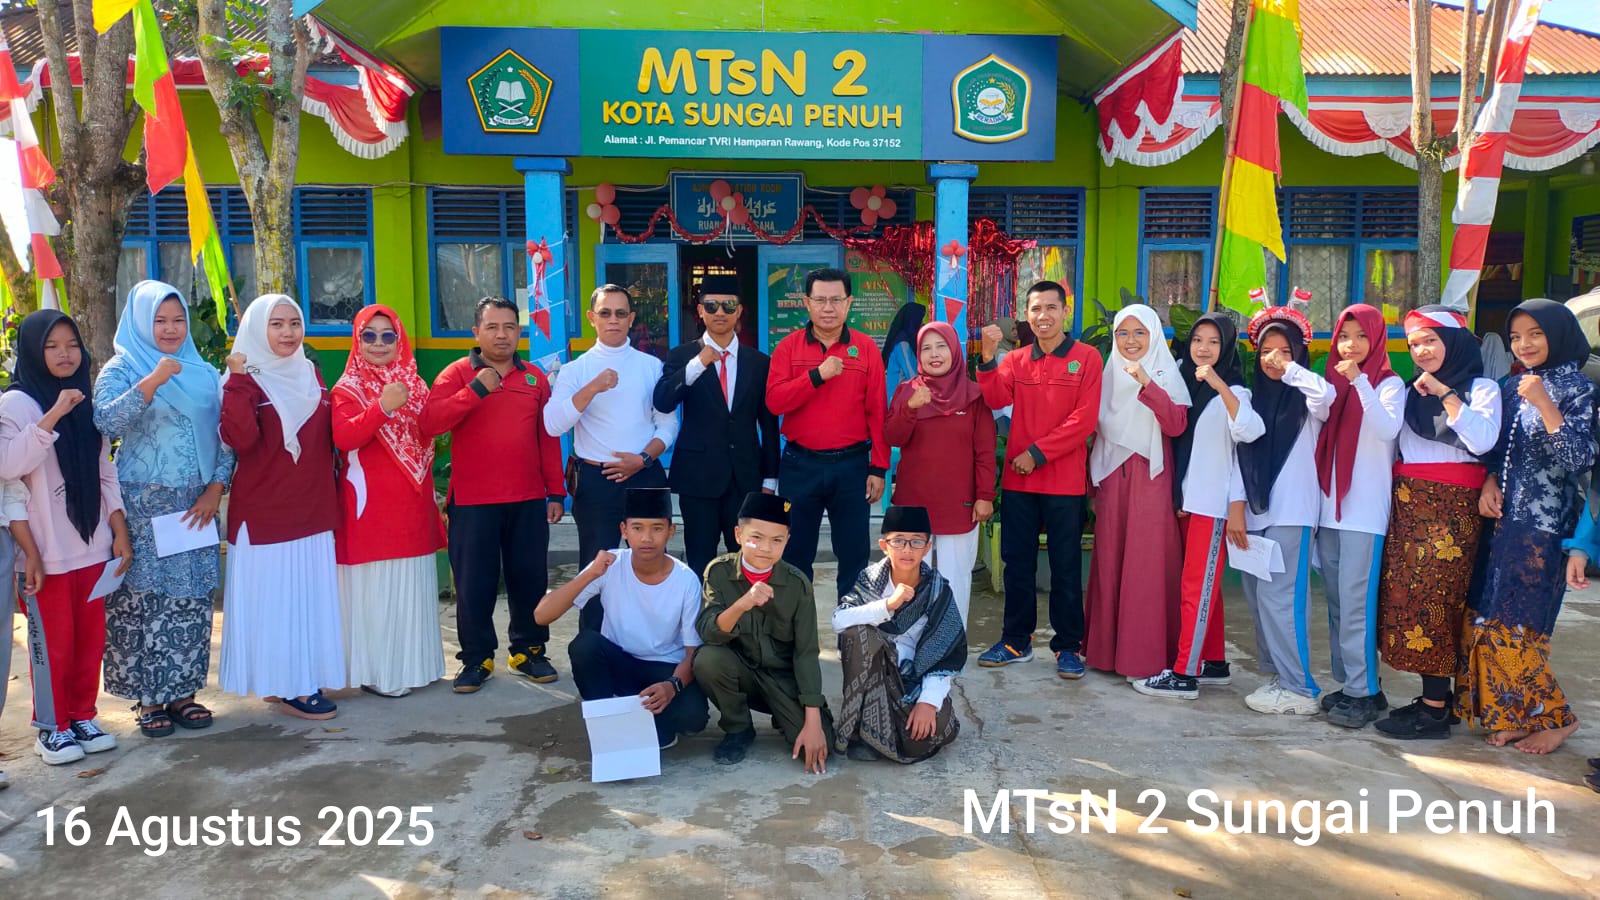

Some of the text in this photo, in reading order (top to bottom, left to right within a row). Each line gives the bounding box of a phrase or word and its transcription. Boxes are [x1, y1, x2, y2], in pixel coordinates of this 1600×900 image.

[638, 47, 868, 97] MTsN 2
[602, 101, 902, 128] KOTA SUNGAI PENUH
[603, 134, 638, 145] Alamat
[658, 135, 707, 146] Pemancar
[708, 136, 731, 146] TVRI
[733, 137, 783, 149] Hamparan
[784, 138, 825, 149] Rawang,
[826, 138, 851, 148] Kode
[853, 138, 871, 148] Pos
[872, 138, 902, 148] 37152
